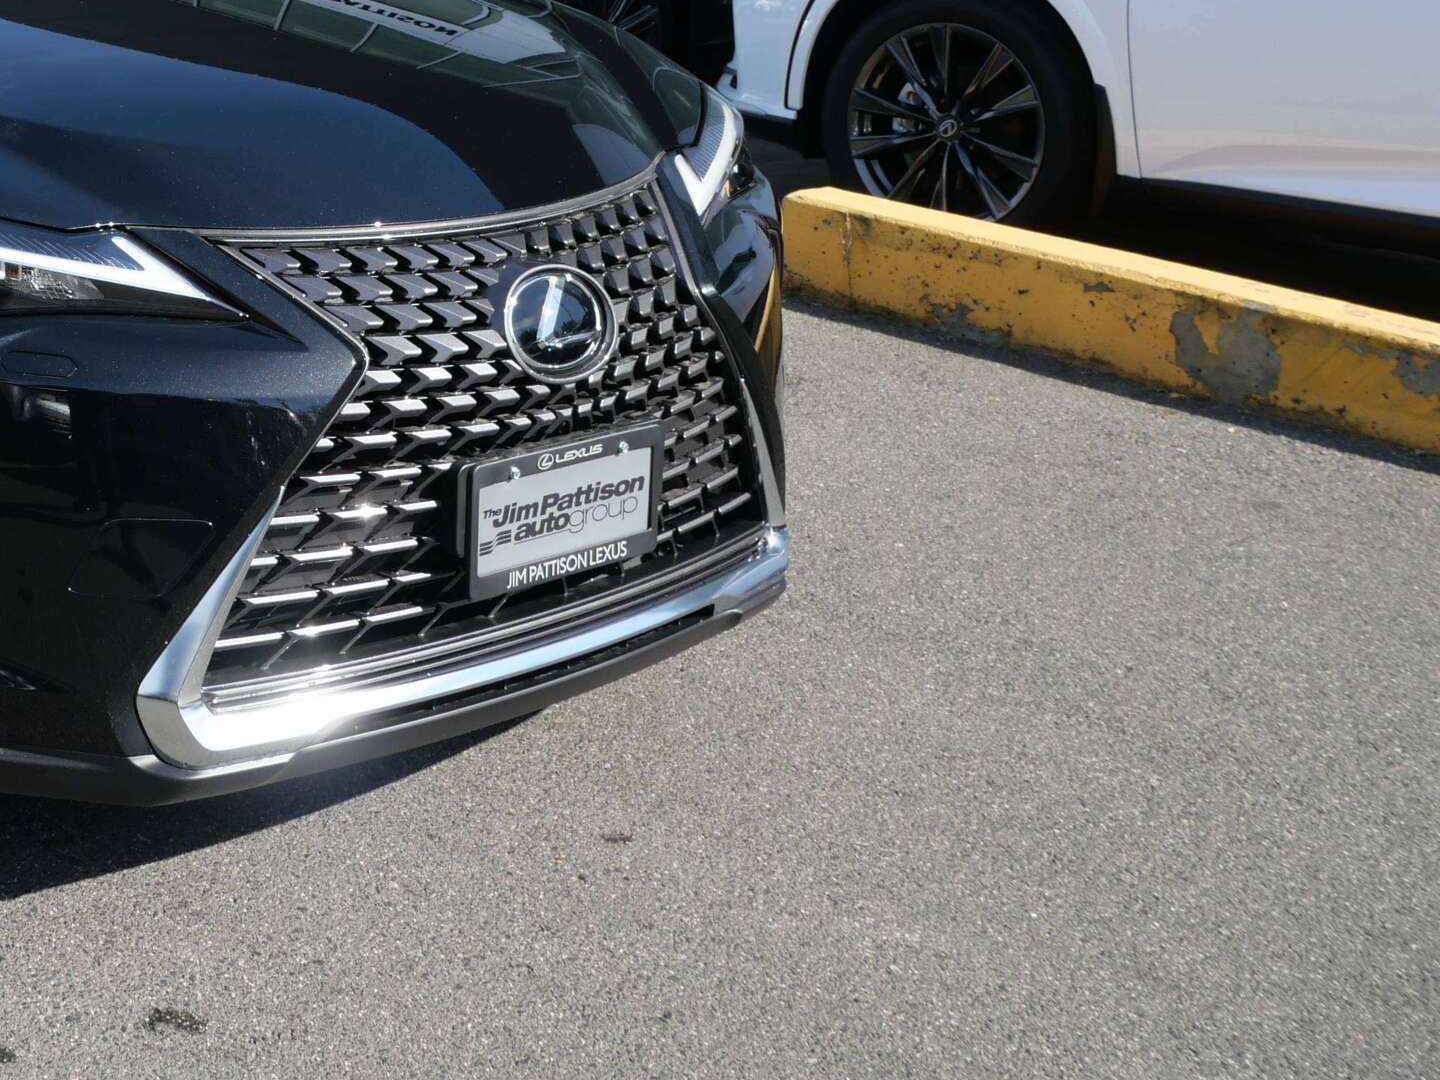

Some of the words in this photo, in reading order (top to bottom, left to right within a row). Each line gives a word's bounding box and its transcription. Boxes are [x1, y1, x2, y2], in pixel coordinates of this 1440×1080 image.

[555, 443, 603, 463] LEXUS
[483, 508, 502, 519] The
[507, 567, 527, 589] JIM
[529, 551, 587, 583] PATTISON
[590, 540, 627, 565] LEXUS
